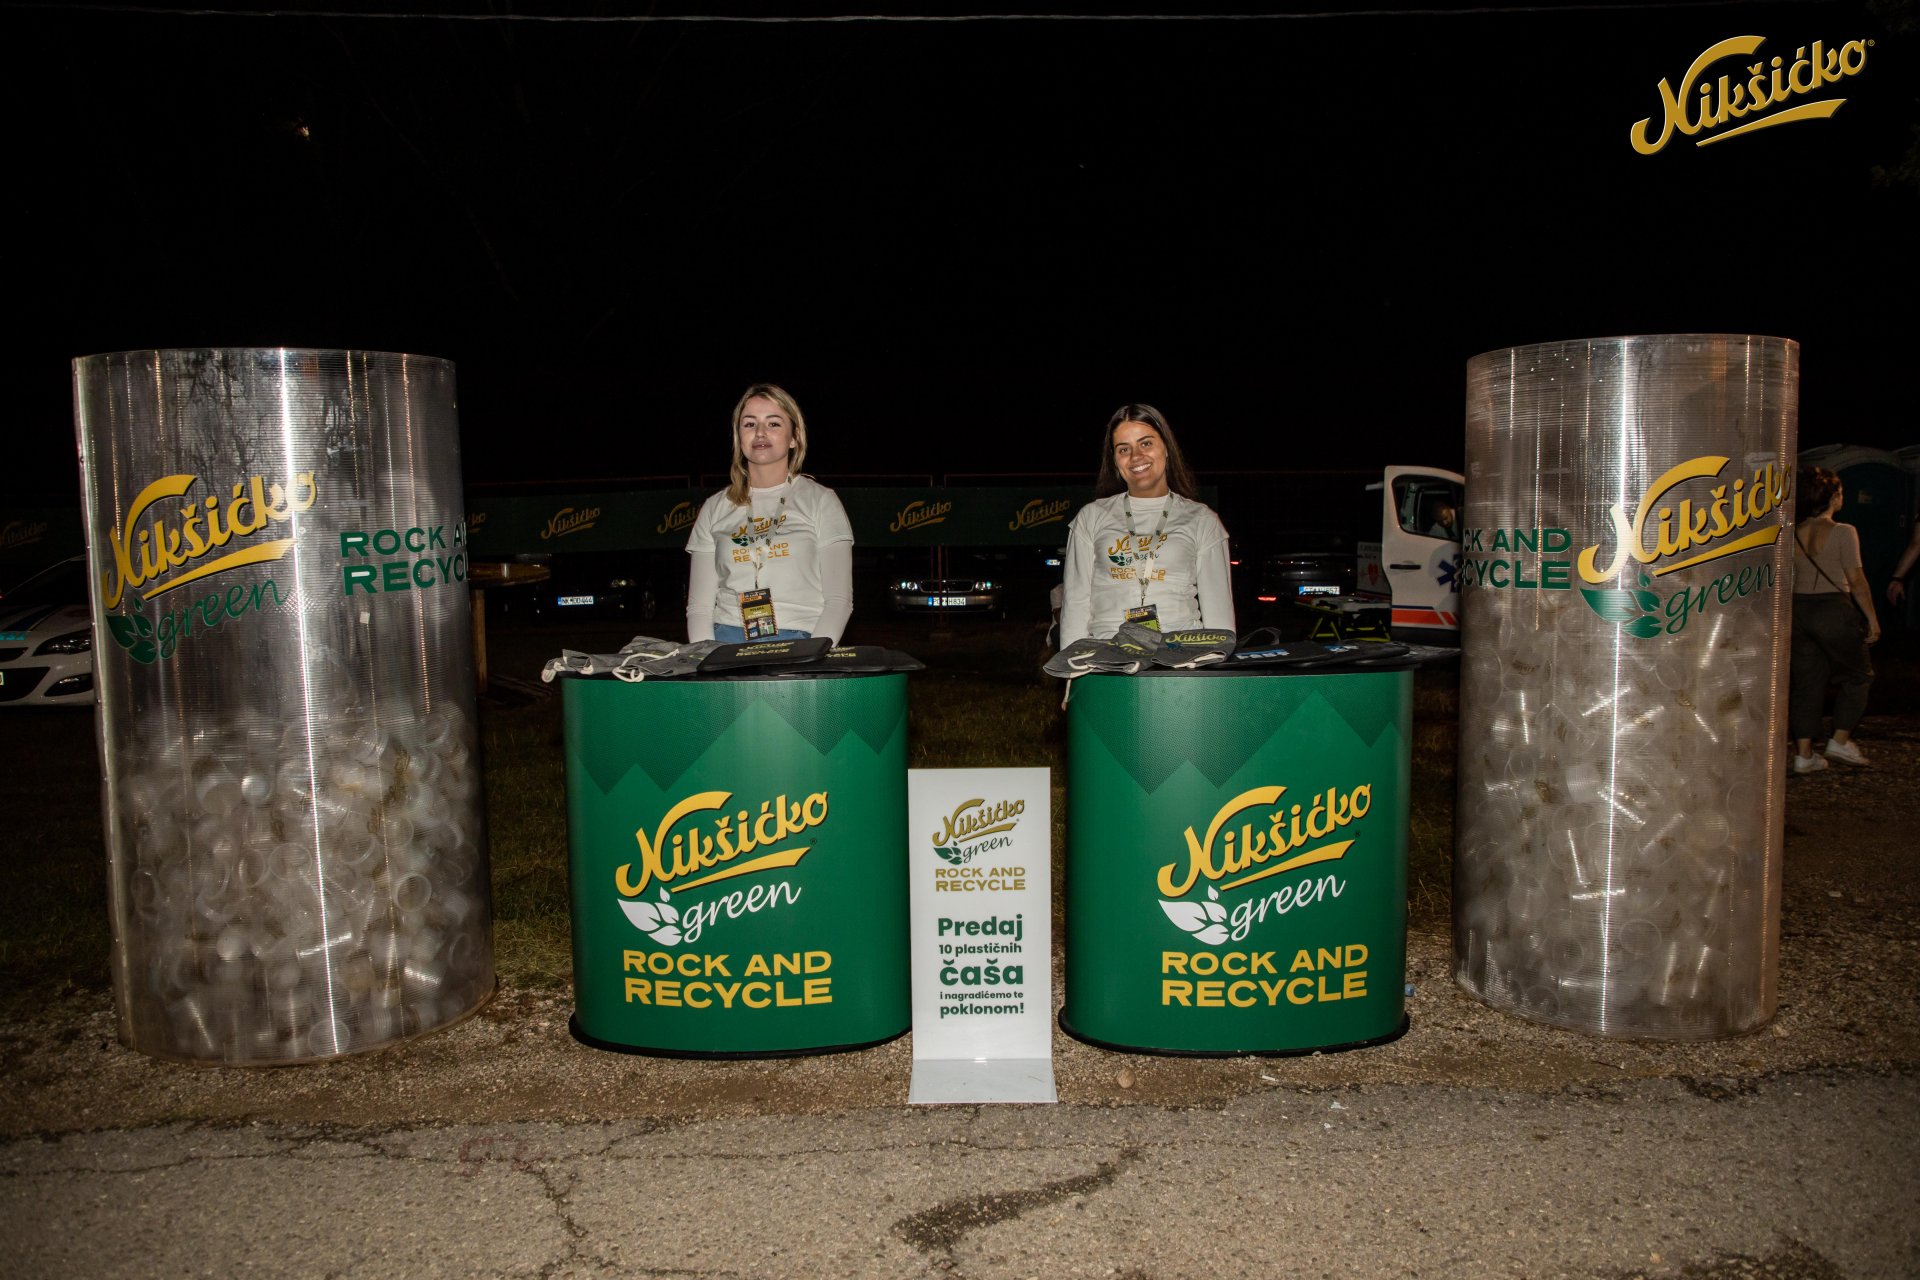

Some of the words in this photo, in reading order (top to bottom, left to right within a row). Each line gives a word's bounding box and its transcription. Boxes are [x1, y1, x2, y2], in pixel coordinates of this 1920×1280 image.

[1577, 456, 1792, 585] Nikšićko
[102, 470, 317, 611] Nikšićko
[341, 526, 446, 557] ROCK
[1492, 528, 1572, 553] AND
[1665, 560, 1777, 635] green
[157, 579, 290, 661] green
[932, 798, 1025, 847] Nikšićko
[615, 791, 828, 898] Nikšićko
[963, 836, 1013, 863] green
[1157, 783, 1371, 898] Nikšićko
[936, 868, 983, 878] ROCK
[989, 867, 1025, 877] AND
[936, 879, 1026, 892] RECYCLE
[682, 881, 802, 943] green
[1230, 875, 1346, 942] green
[938, 914, 1023, 941] Predaj
[624, 949, 732, 977] ROCK
[744, 950, 832, 977] AND
[939, 944, 952, 954] 10
[955, 942, 1022, 957] plastičnih
[1162, 951, 1278, 976] ROCK
[1290, 944, 1369, 972] AND
[939, 958, 1024, 986] čaša
[625, 977, 832, 1009] RECYCLE
[945, 991, 1011, 1001] nagradićemo
[1013, 991, 1024, 999] te
[1162, 971, 1368, 1008] RECYCLE
[940, 1002, 1024, 1018] poklonom!
